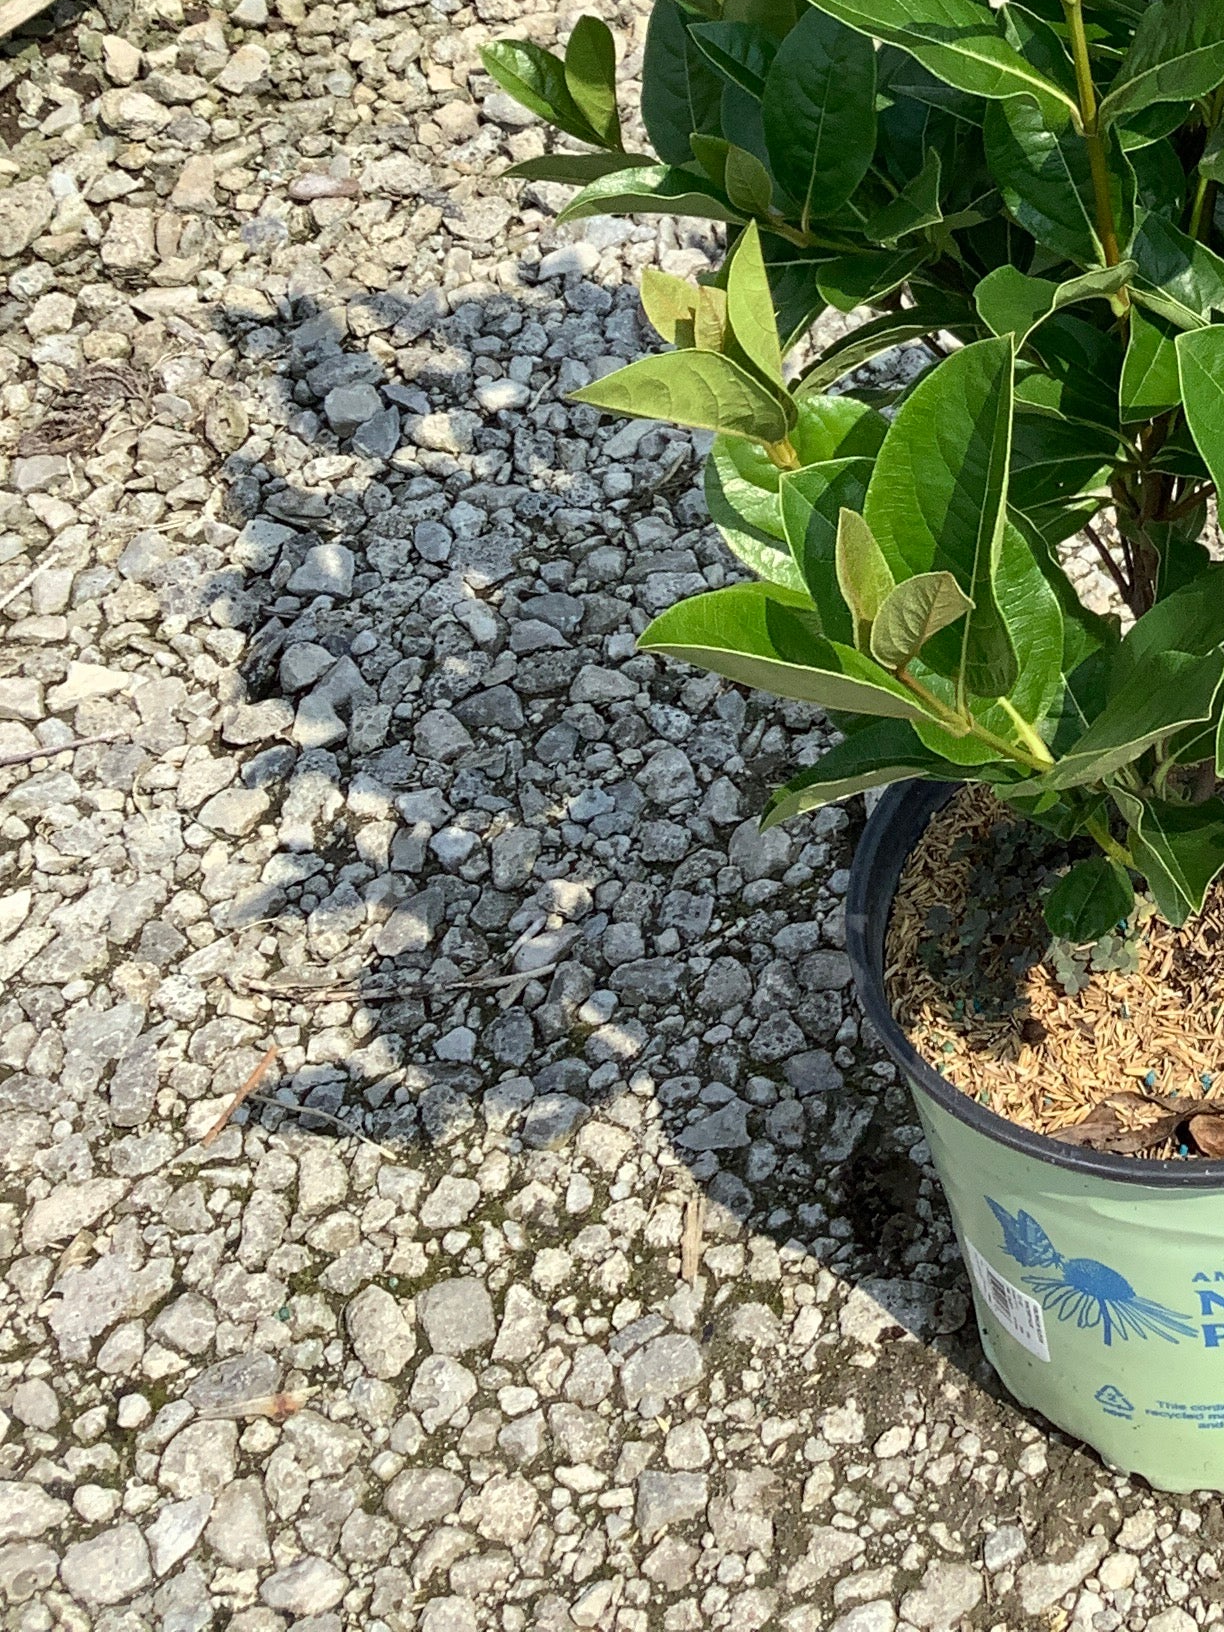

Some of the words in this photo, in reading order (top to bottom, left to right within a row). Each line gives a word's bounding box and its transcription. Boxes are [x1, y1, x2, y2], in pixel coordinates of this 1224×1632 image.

[1156, 1400, 1187, 1411] This
[1145, 1409, 1205, 1419] recycled
[1198, 1420, 1224, 1429] and
